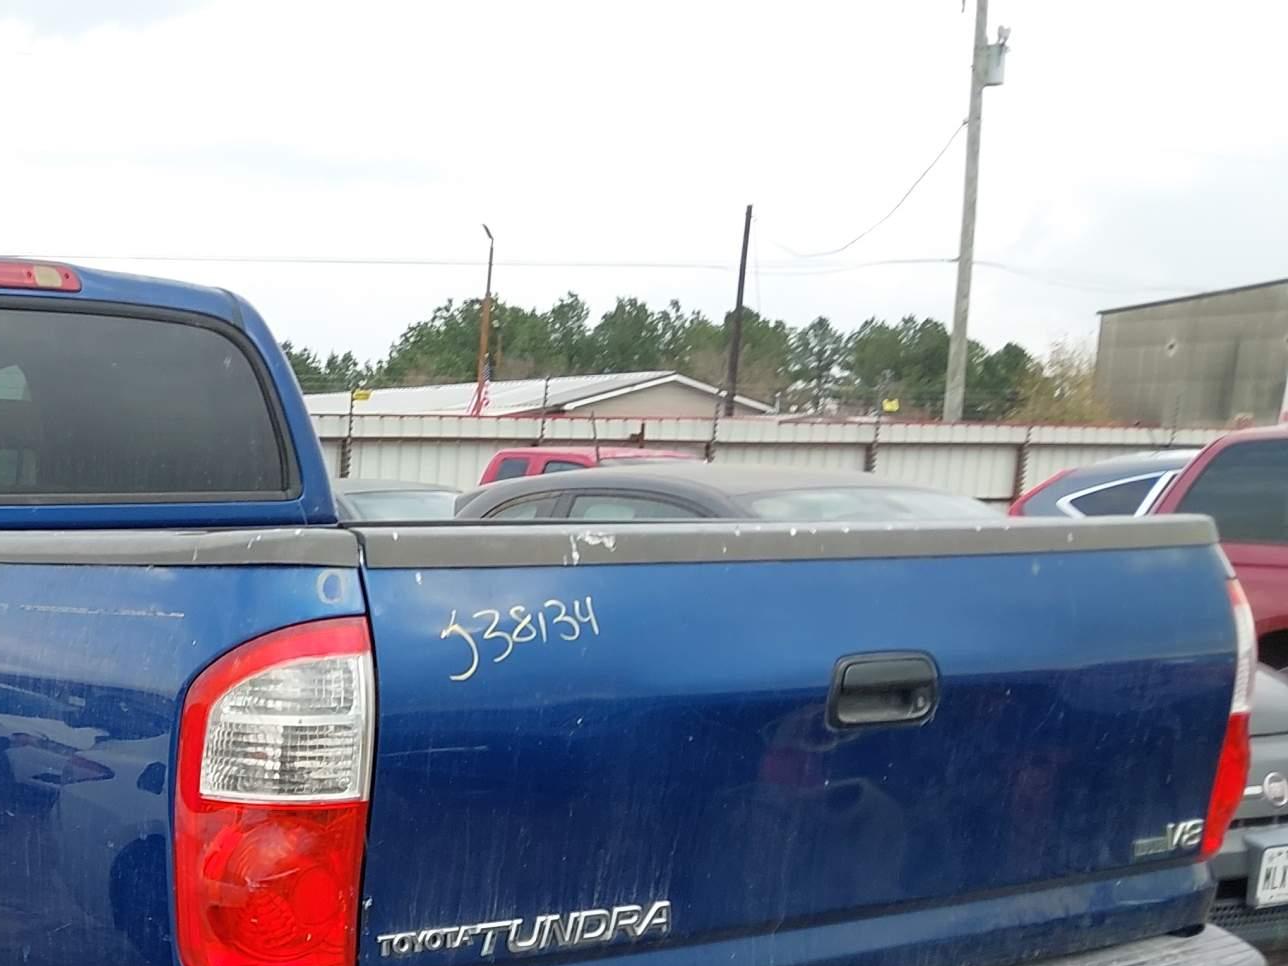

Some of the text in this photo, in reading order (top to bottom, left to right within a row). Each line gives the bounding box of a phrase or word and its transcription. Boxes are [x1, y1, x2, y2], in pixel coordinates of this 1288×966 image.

[1166, 818, 1204, 849] V8
[377, 900, 672, 957] TOYOTA TUNDRA
